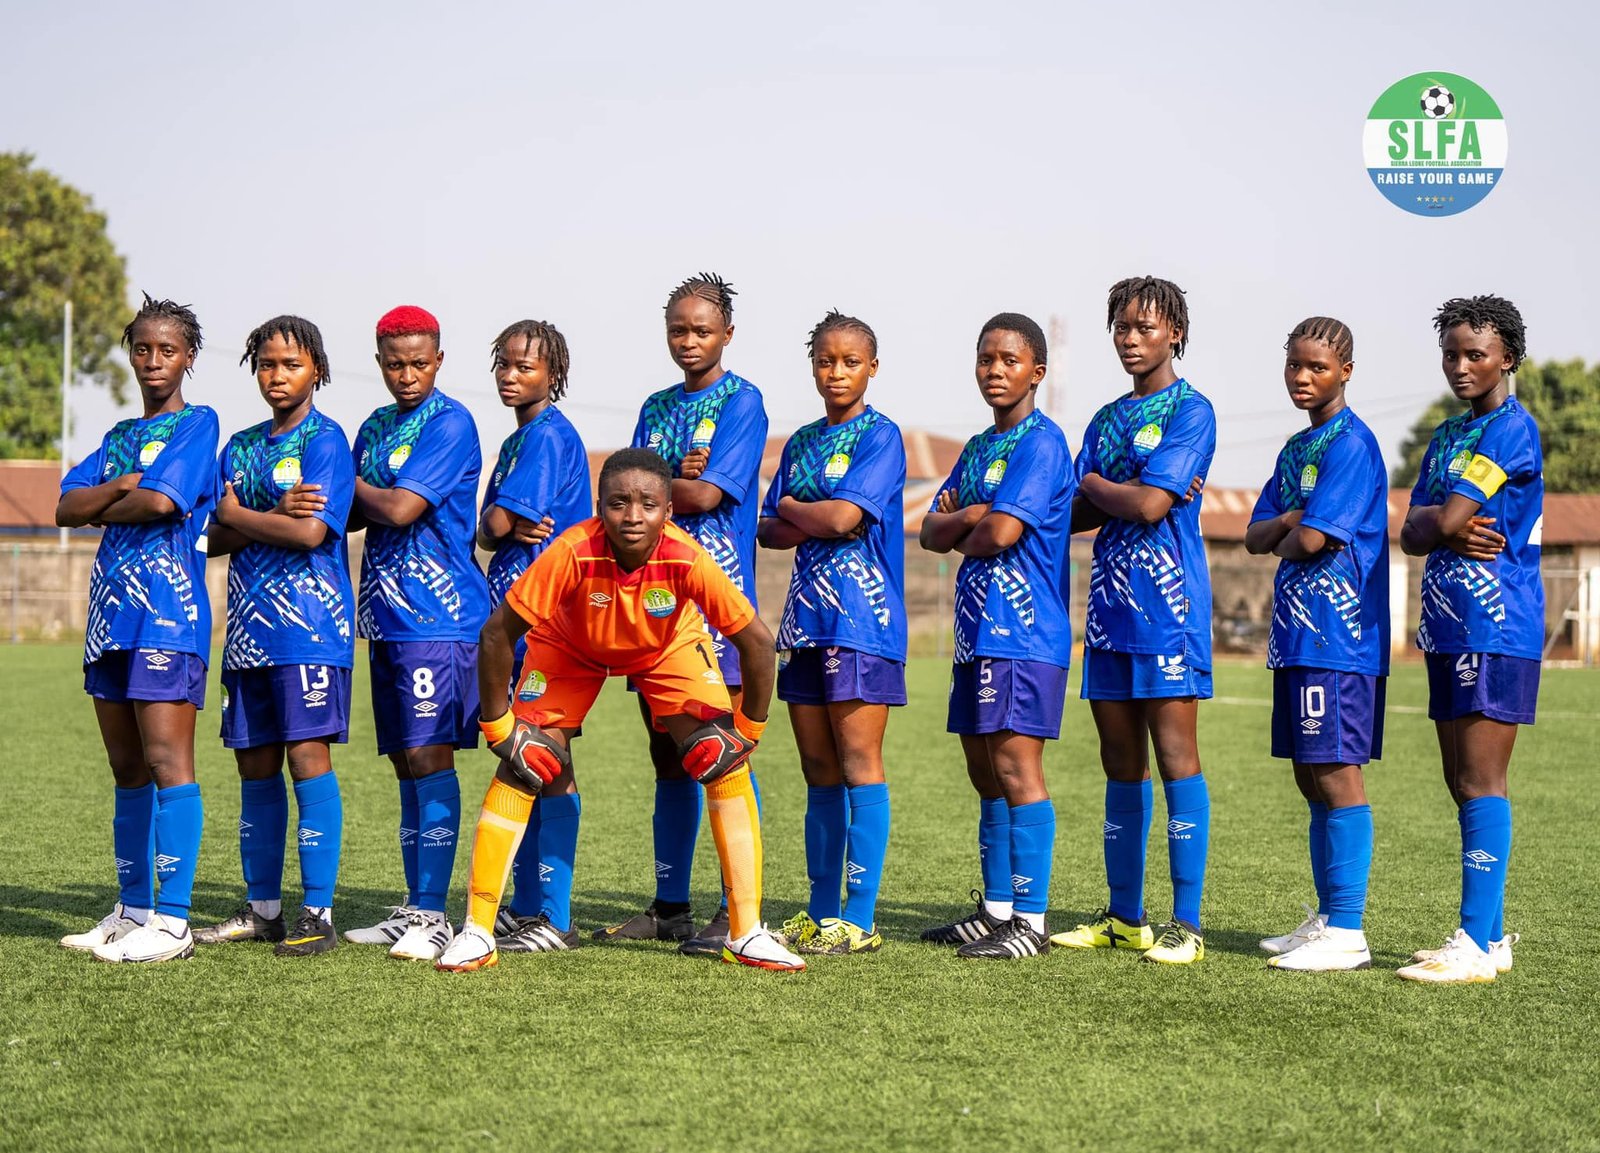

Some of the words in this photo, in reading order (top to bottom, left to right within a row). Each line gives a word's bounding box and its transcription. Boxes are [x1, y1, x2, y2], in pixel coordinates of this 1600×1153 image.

[648, 596, 671, 608] SLFA
[300, 664, 329, 691] 13
[413, 667, 435, 699] 8
[980, 659, 992, 684] 5
[1300, 686, 1326, 717] 10
[423, 840, 452, 848] umbro
[1463, 861, 1491, 872] umbro
